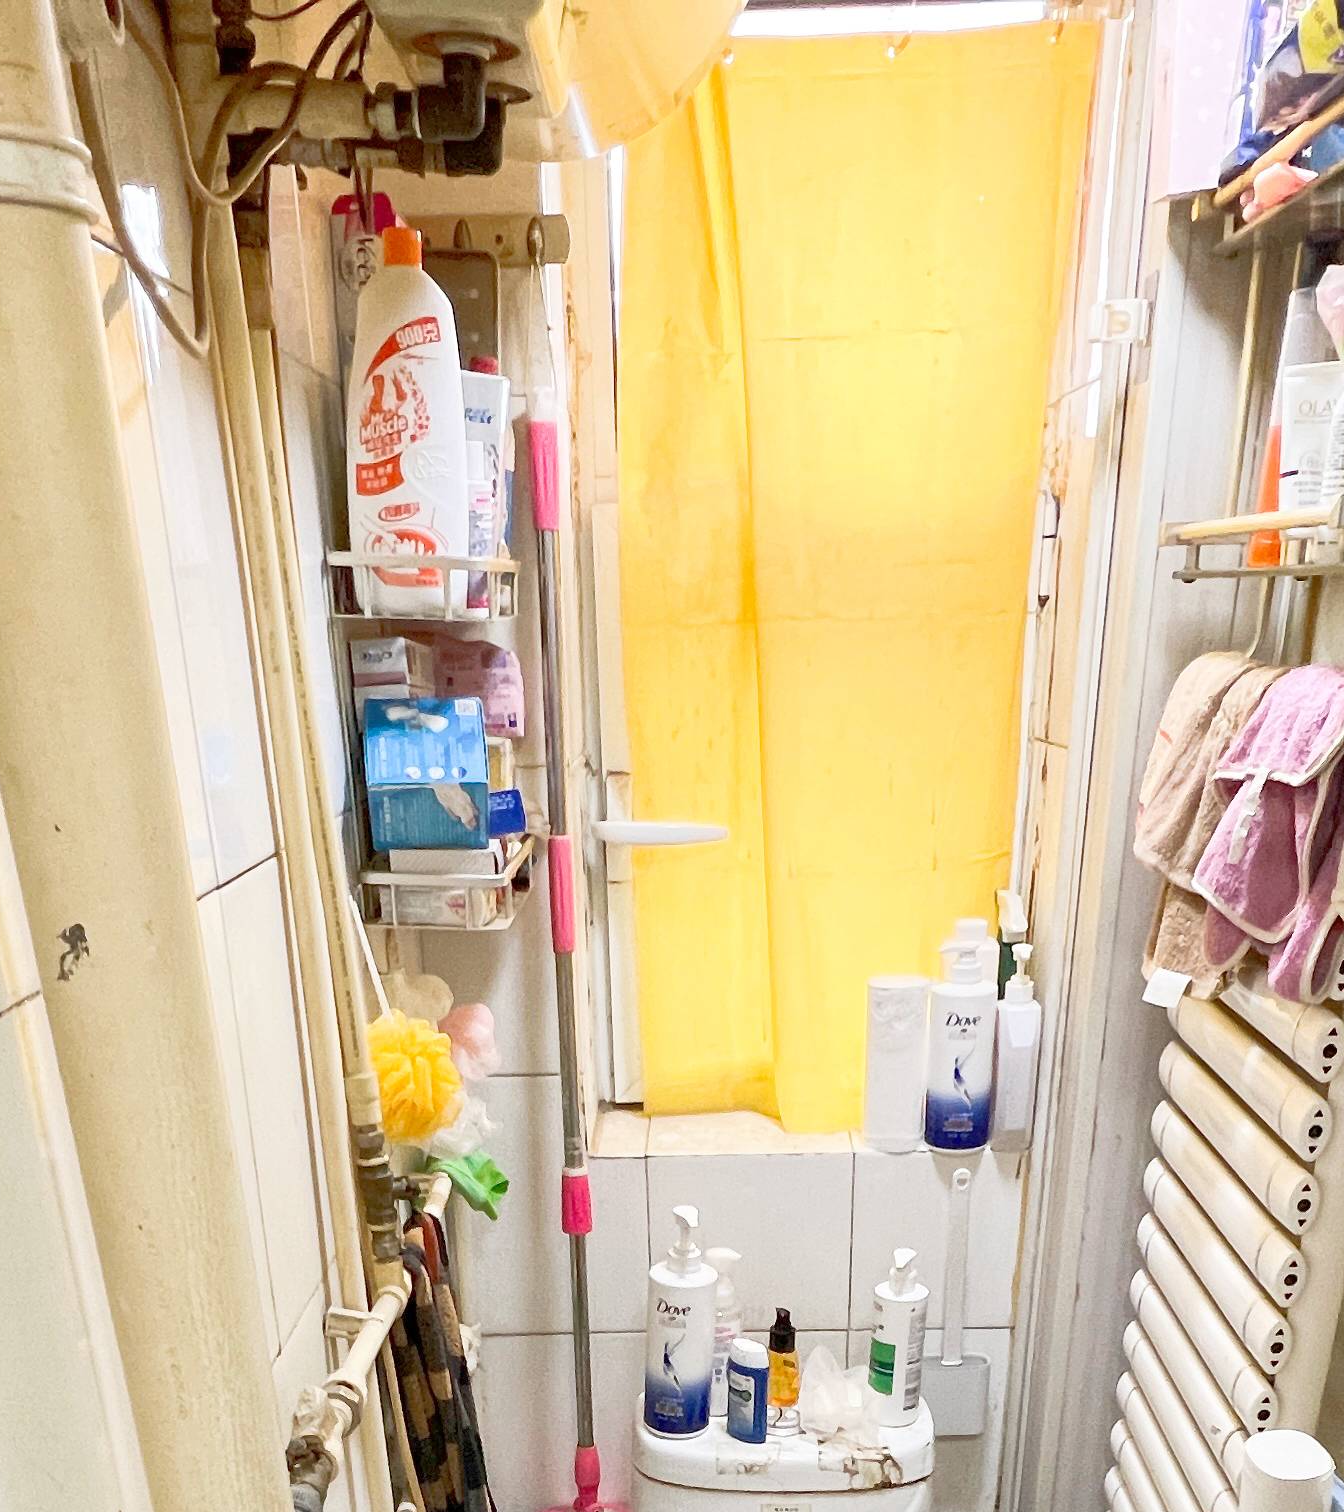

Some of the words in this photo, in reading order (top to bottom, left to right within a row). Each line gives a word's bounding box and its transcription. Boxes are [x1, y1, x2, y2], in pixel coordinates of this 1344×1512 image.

[360, 412, 408, 443] Muscle
[944, 1010, 982, 1027] Dove
[656, 1297, 692, 1316] Dove
